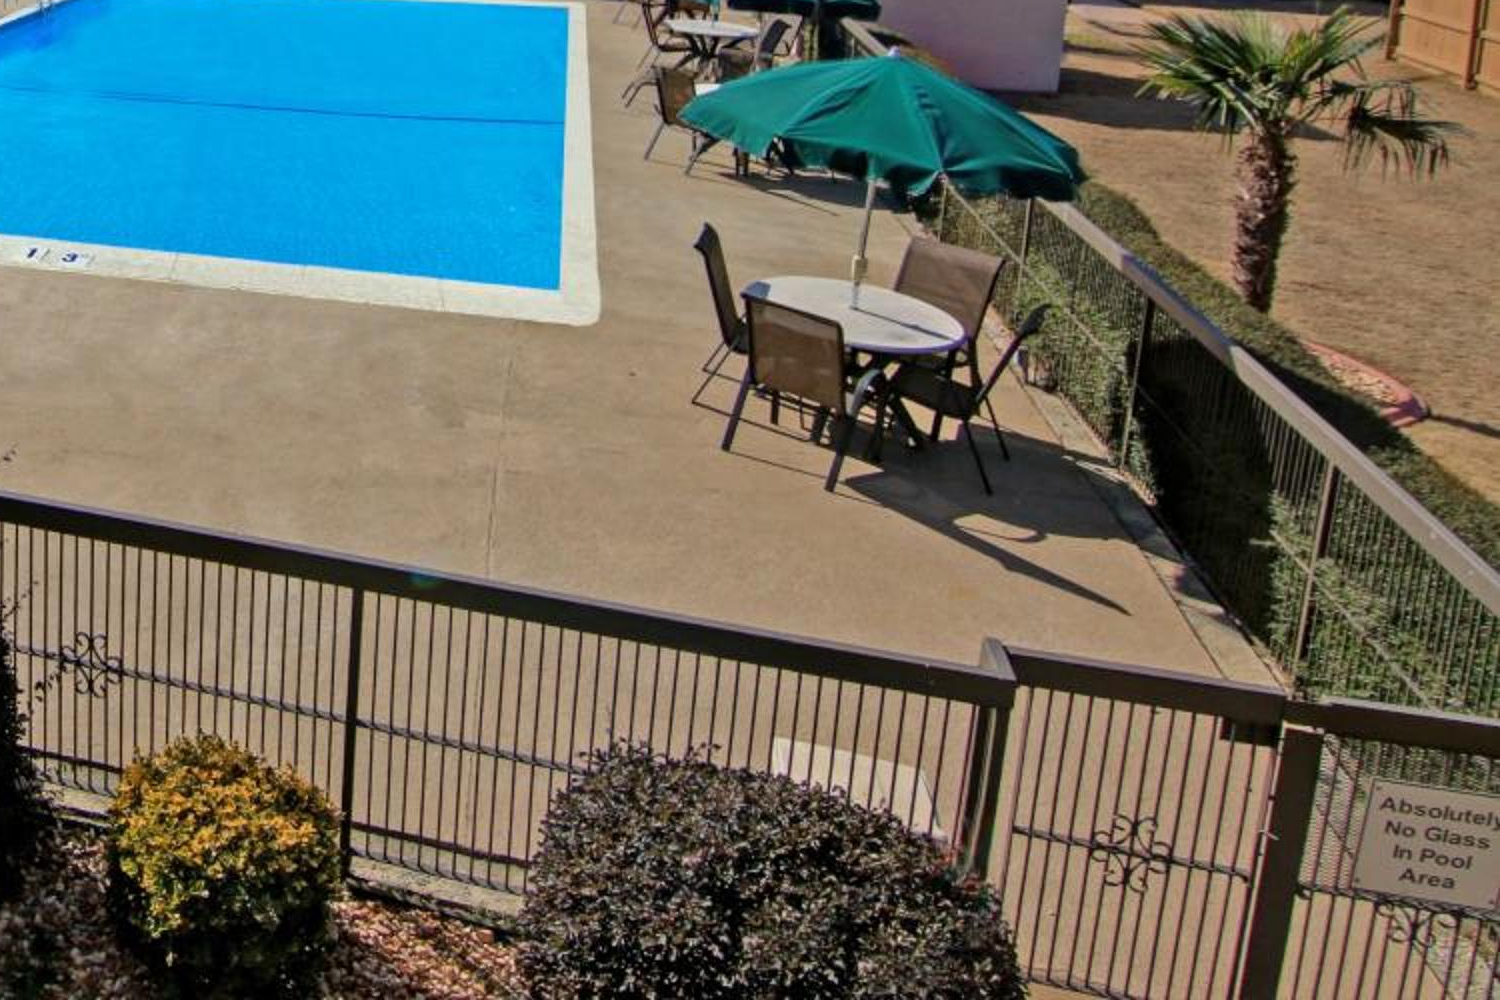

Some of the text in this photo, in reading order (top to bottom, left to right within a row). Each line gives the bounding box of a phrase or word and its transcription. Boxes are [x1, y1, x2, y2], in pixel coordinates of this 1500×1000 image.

[1385, 821, 1491, 849] No Glass
[1393, 845, 1473, 870] In Pool
[1399, 868, 1455, 889] Area
